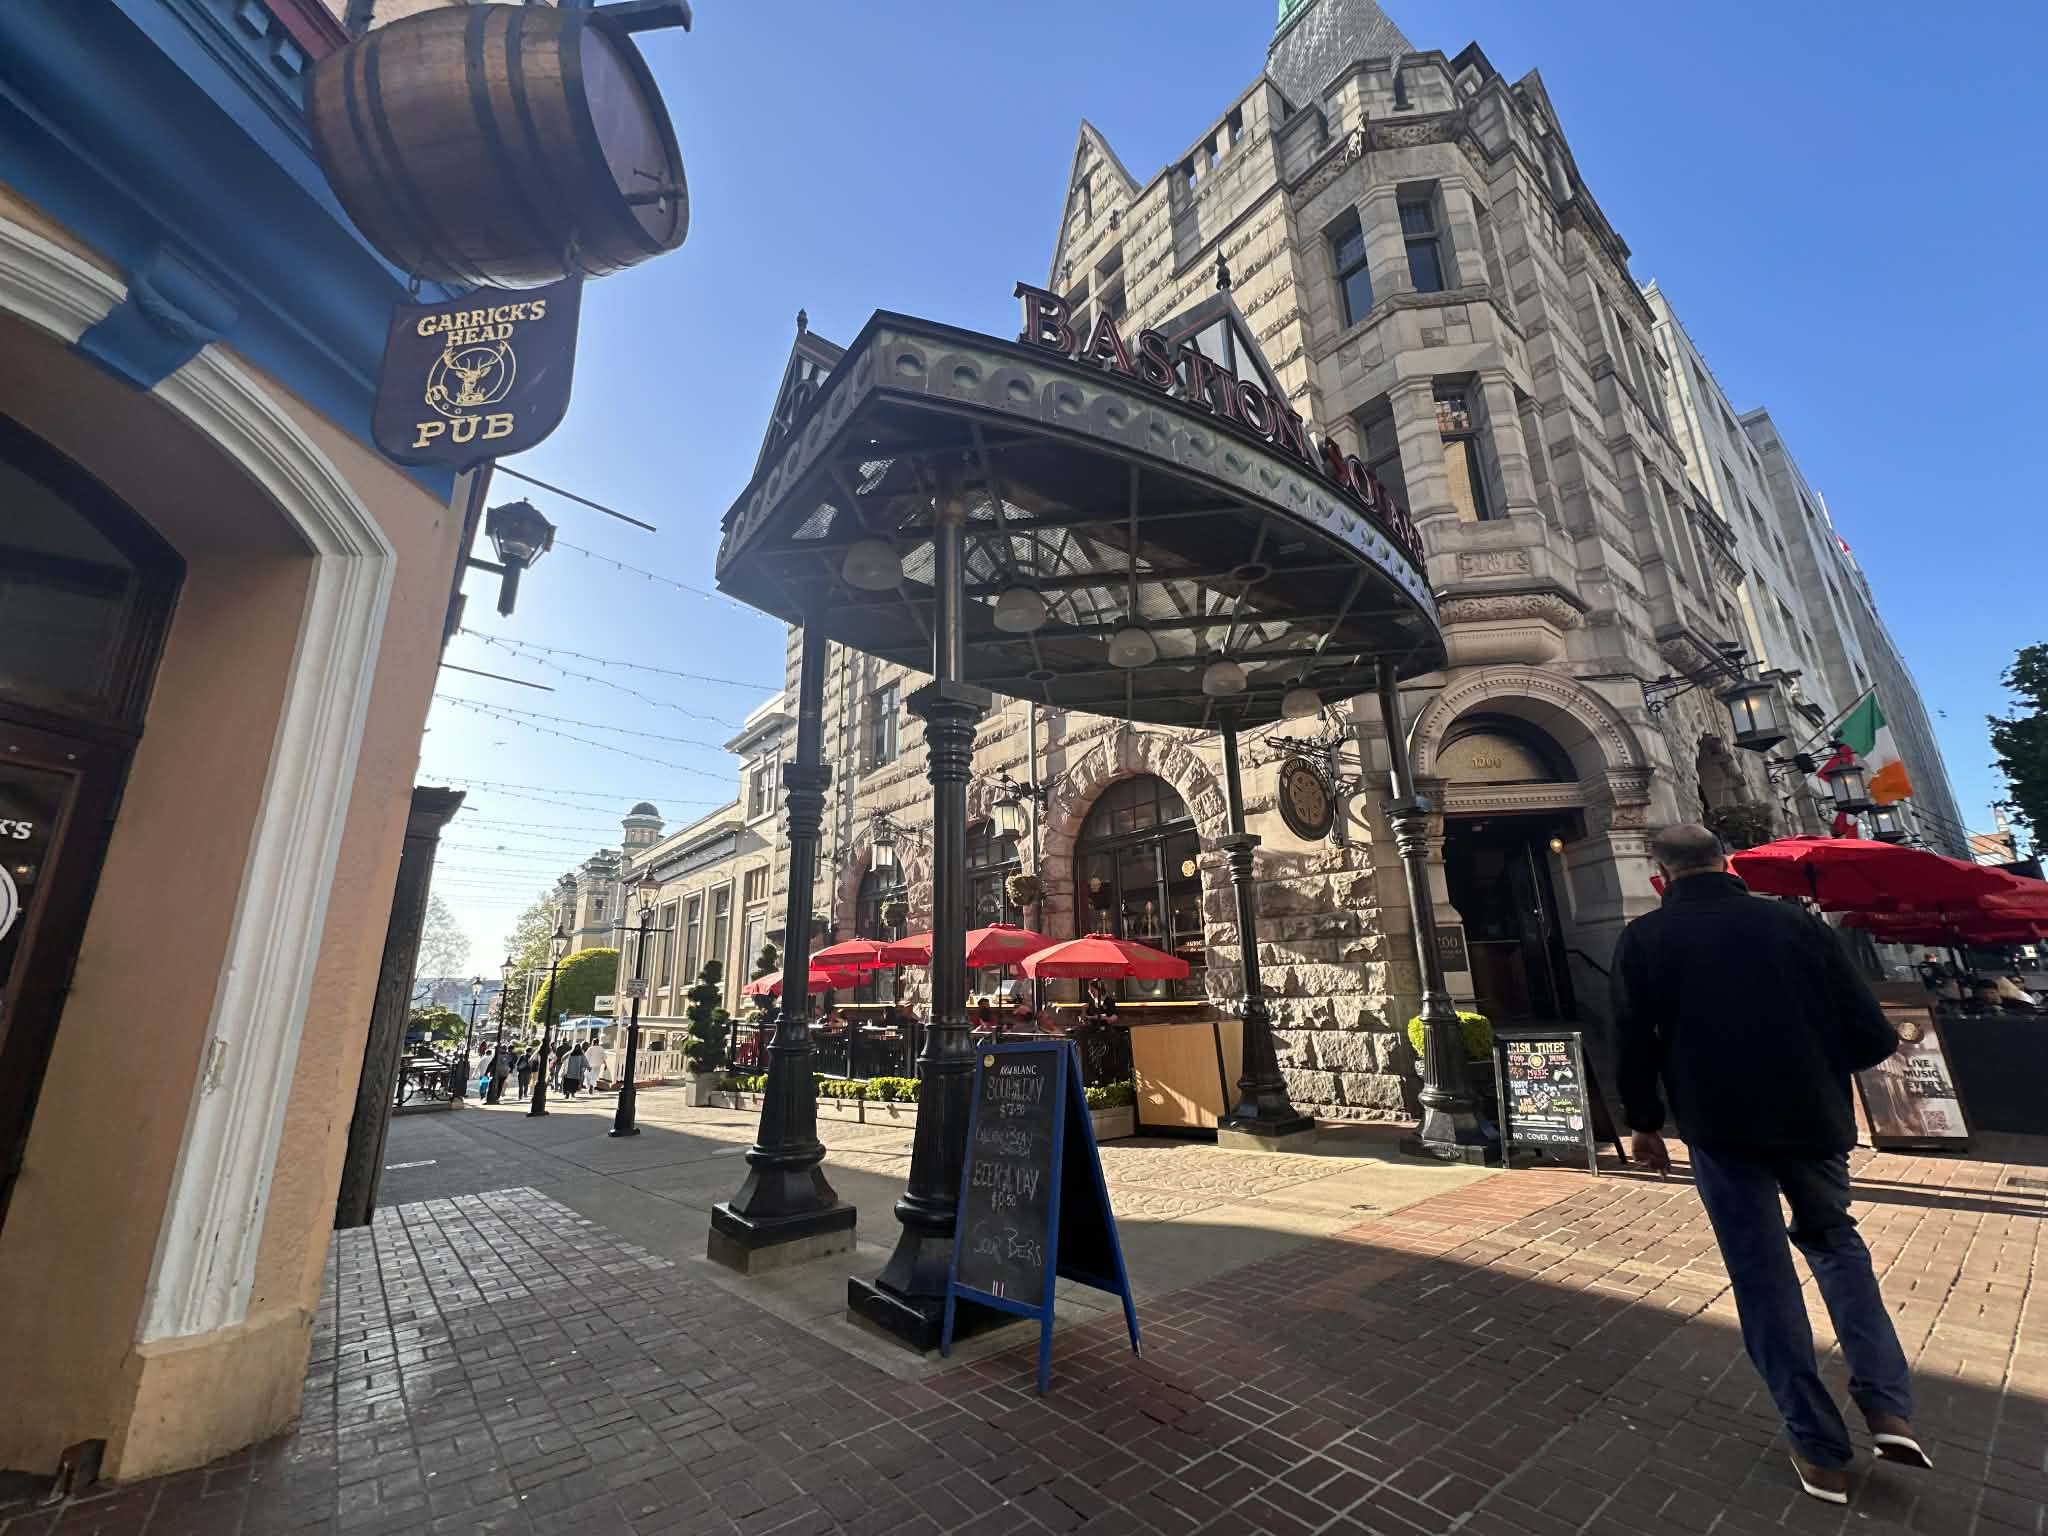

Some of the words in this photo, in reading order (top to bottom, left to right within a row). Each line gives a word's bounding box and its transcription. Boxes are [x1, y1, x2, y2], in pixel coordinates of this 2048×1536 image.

[416, 300, 546, 337] GARRICK'S
[445, 323, 514, 347] HEAD
[1013, 281, 1316, 463] BASTION
[412, 413, 514, 448] PUB
[1536, 1042, 1566, 1053] TIMES
[1906, 1059, 1931, 1068] LIVE
[1904, 1070, 1940, 1080] MUSIC
[1513, 1132, 1524, 1140] NO
[1527, 1133, 1548, 1141] COVER
[1551, 1134, 1580, 1142] CHARGE
